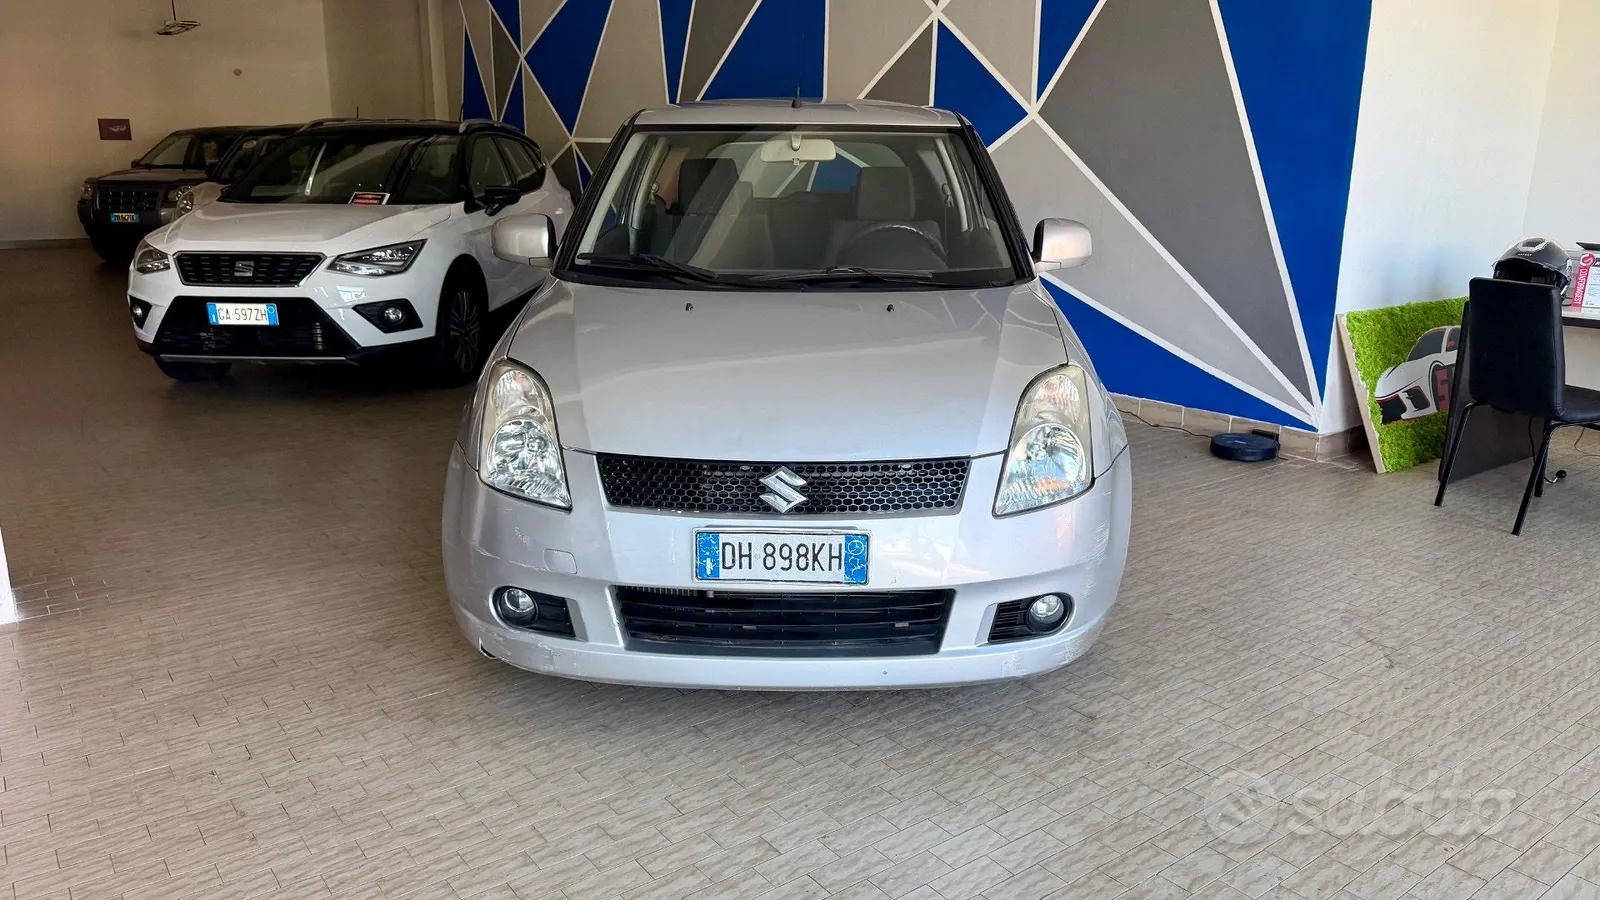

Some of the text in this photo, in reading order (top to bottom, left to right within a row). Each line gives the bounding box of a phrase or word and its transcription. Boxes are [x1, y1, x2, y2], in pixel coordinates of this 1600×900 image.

[234, 307, 267, 321] 597ZH
[721, 541, 843, 572] DH 898KH
